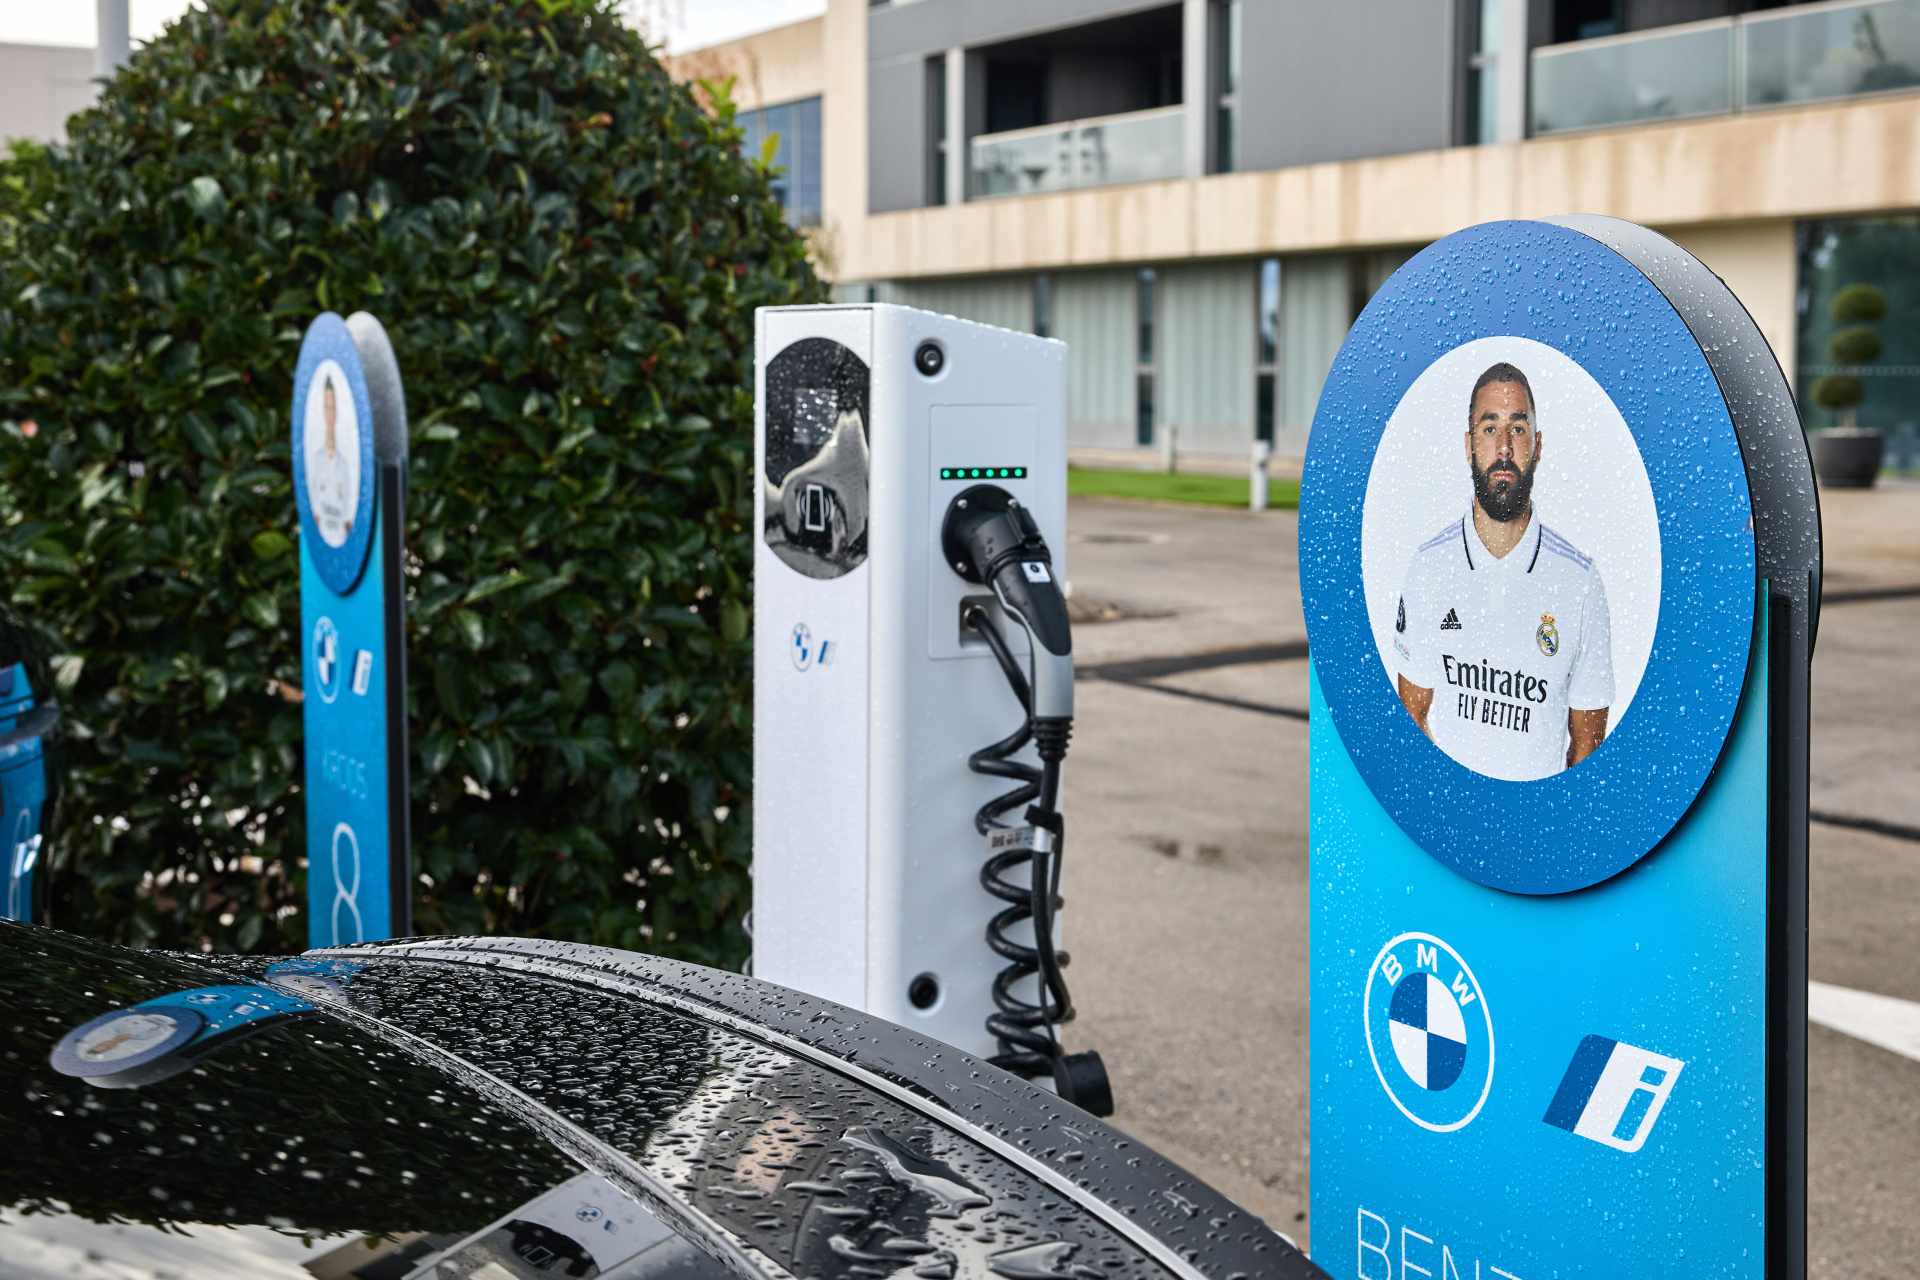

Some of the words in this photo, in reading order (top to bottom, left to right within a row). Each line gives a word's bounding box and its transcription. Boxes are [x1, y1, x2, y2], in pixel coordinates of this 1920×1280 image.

[1440, 621, 1462, 630] adidas
[1442, 654, 1548, 703] Emirates
[1458, 693, 1478, 720] FLY
[1482, 699, 1530, 733] BETTER
[1381, 943, 1476, 1006] BMW
